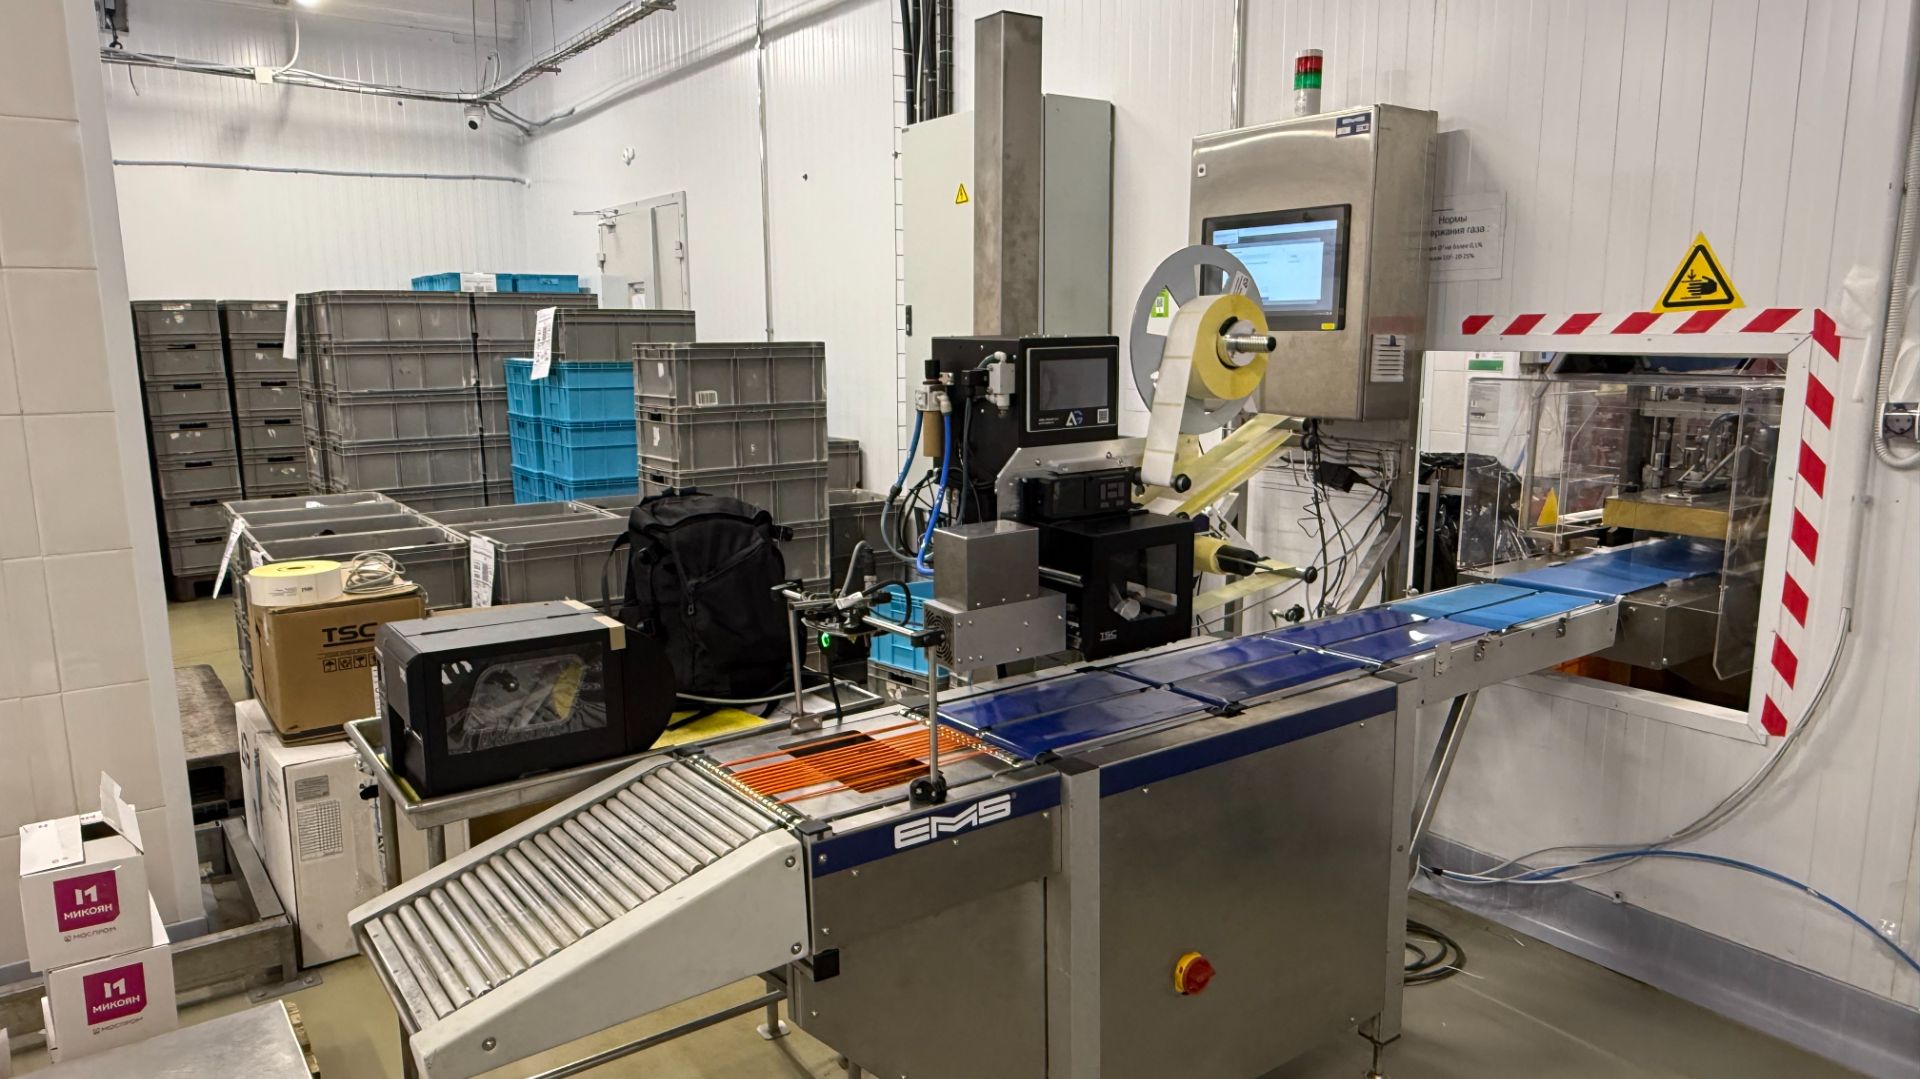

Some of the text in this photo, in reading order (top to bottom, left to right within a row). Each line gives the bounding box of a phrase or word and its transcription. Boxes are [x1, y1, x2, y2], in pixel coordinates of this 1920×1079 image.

[1438, 215, 1468, 225] Нормы
[1430, 229, 1465, 238] ержания
[321, 622, 378, 642] TSC
[894, 794, 1011, 849] EMS
[63, 903, 113, 921] МИКОЯН
[92, 994, 141, 1014] МИКОЯН
